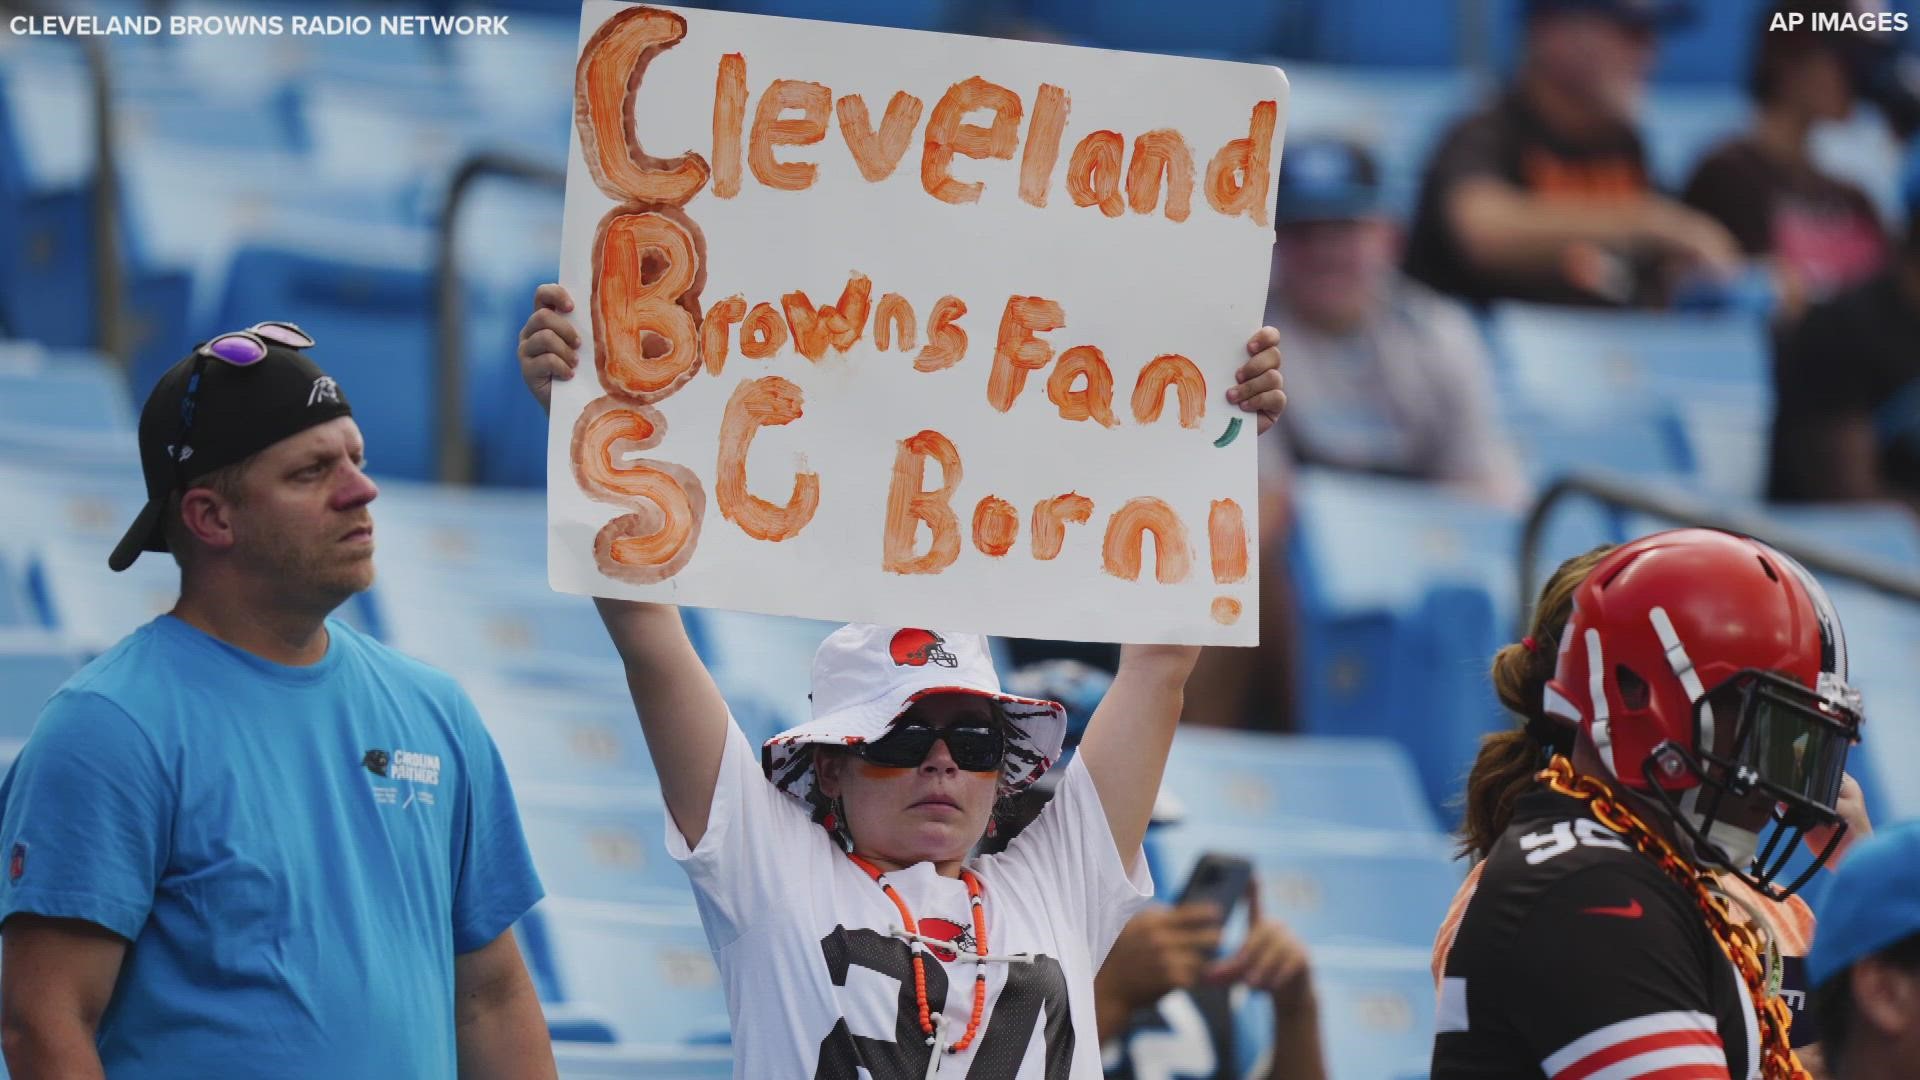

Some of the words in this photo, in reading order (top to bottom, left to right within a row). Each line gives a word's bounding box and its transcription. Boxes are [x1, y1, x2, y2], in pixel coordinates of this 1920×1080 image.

[575, 5, 1278, 226] Cleveland
[591, 203, 969, 404] Browns
[986, 294, 1244, 448] Fan,
[570, 376, 821, 584] SC
[882, 429, 1249, 626] Born!
